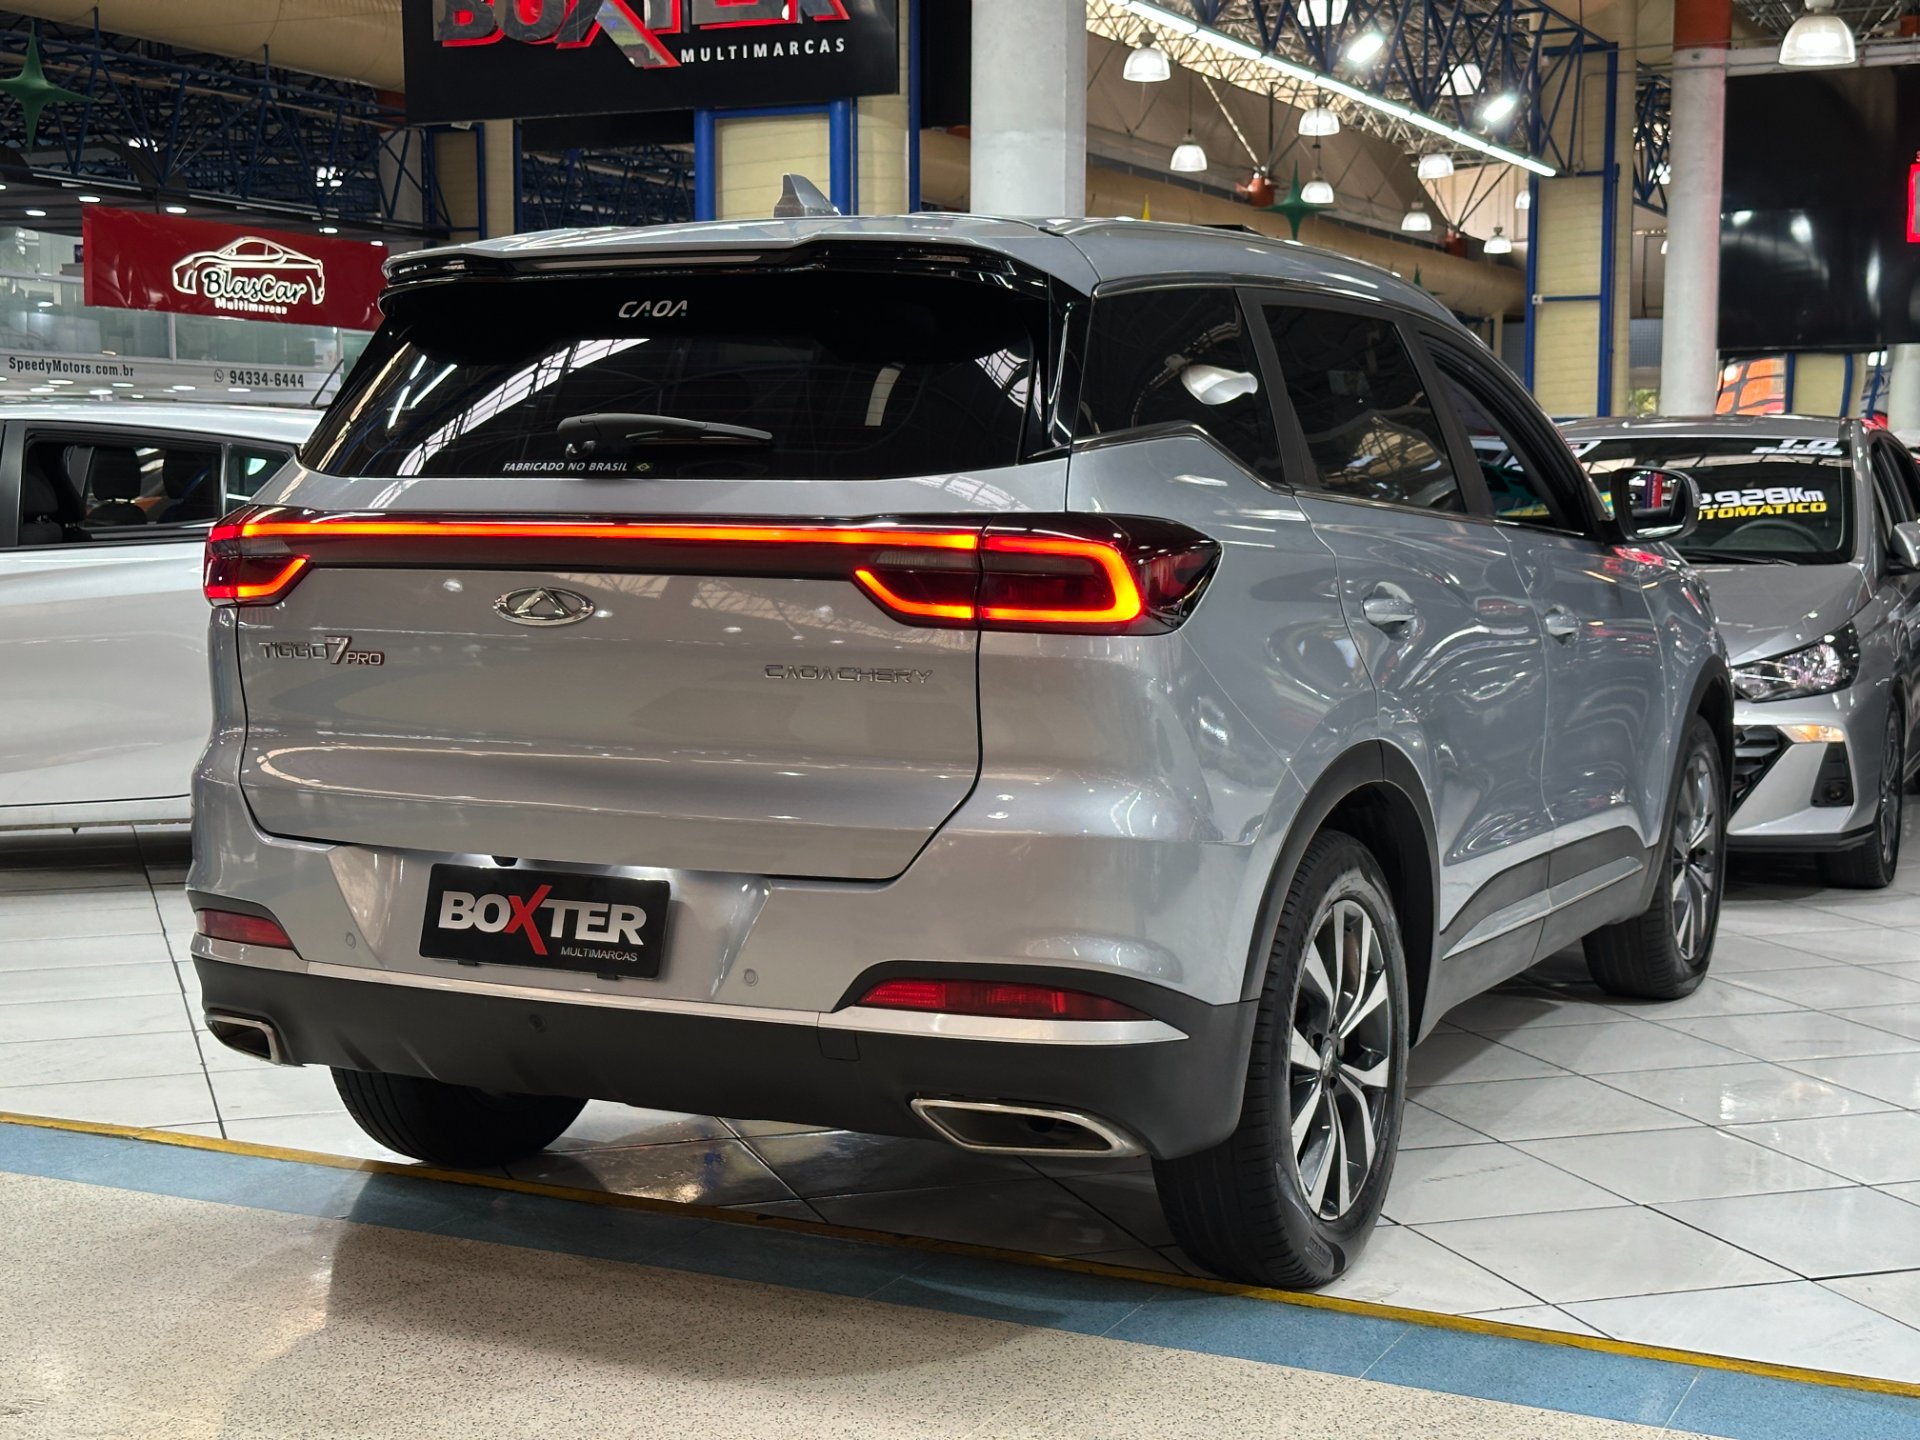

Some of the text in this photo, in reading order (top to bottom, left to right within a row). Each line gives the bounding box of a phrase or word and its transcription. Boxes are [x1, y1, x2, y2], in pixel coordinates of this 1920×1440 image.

[680, 37, 847, 64] MULTIMARCAS
[201, 266, 307, 304] BlasCar
[214, 297, 288, 315] Multimarcas
[618, 299, 688, 318] CAOA
[8, 356, 135, 378] SpeedyMotors.com.br
[229, 370, 305, 388] 94334-6444
[502, 461, 628, 472] FABRICADO NO BRASIL
[1698, 501, 1827, 520] TOMATICO
[438, 884, 648, 956] BOXTER
[560, 946, 639, 963] MULTIMARCAS
